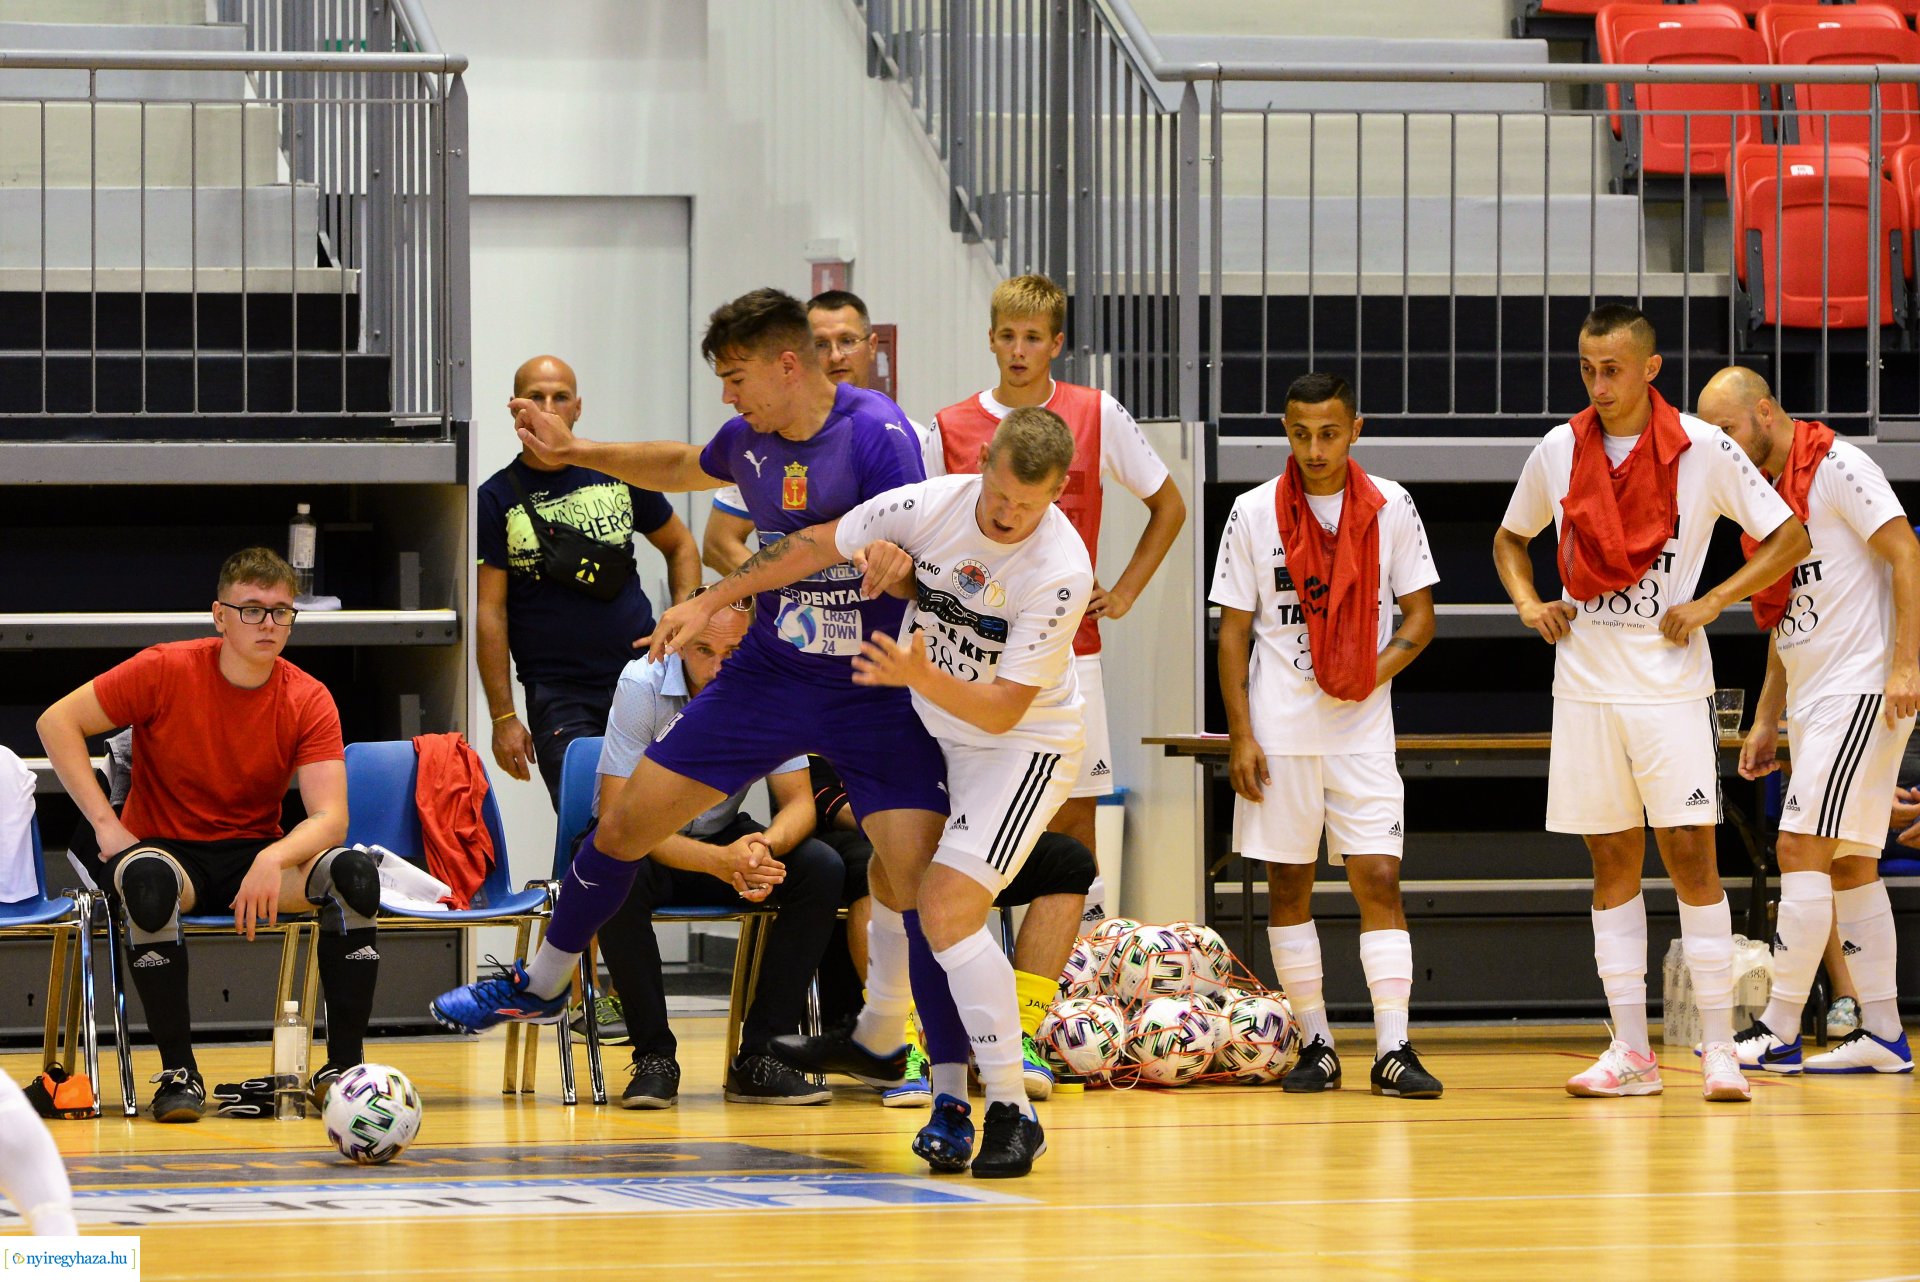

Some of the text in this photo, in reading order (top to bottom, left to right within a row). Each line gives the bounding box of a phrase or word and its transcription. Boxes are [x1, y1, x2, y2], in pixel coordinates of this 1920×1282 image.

[579, 510, 632, 539] HERO
[1272, 547, 1285, 556] JA
[916, 560, 941, 576] AKO
[822, 608, 857, 625] CRAZY
[822, 623, 857, 640] TOWN
[821, 640, 836, 655] 24
[959, 635, 1003, 666] KFT
[1685, 797, 1710, 807] adidas
[133, 957, 171, 968] adidas
[345, 952, 381, 961] adidas
[969, 1034, 998, 1044] AKO
